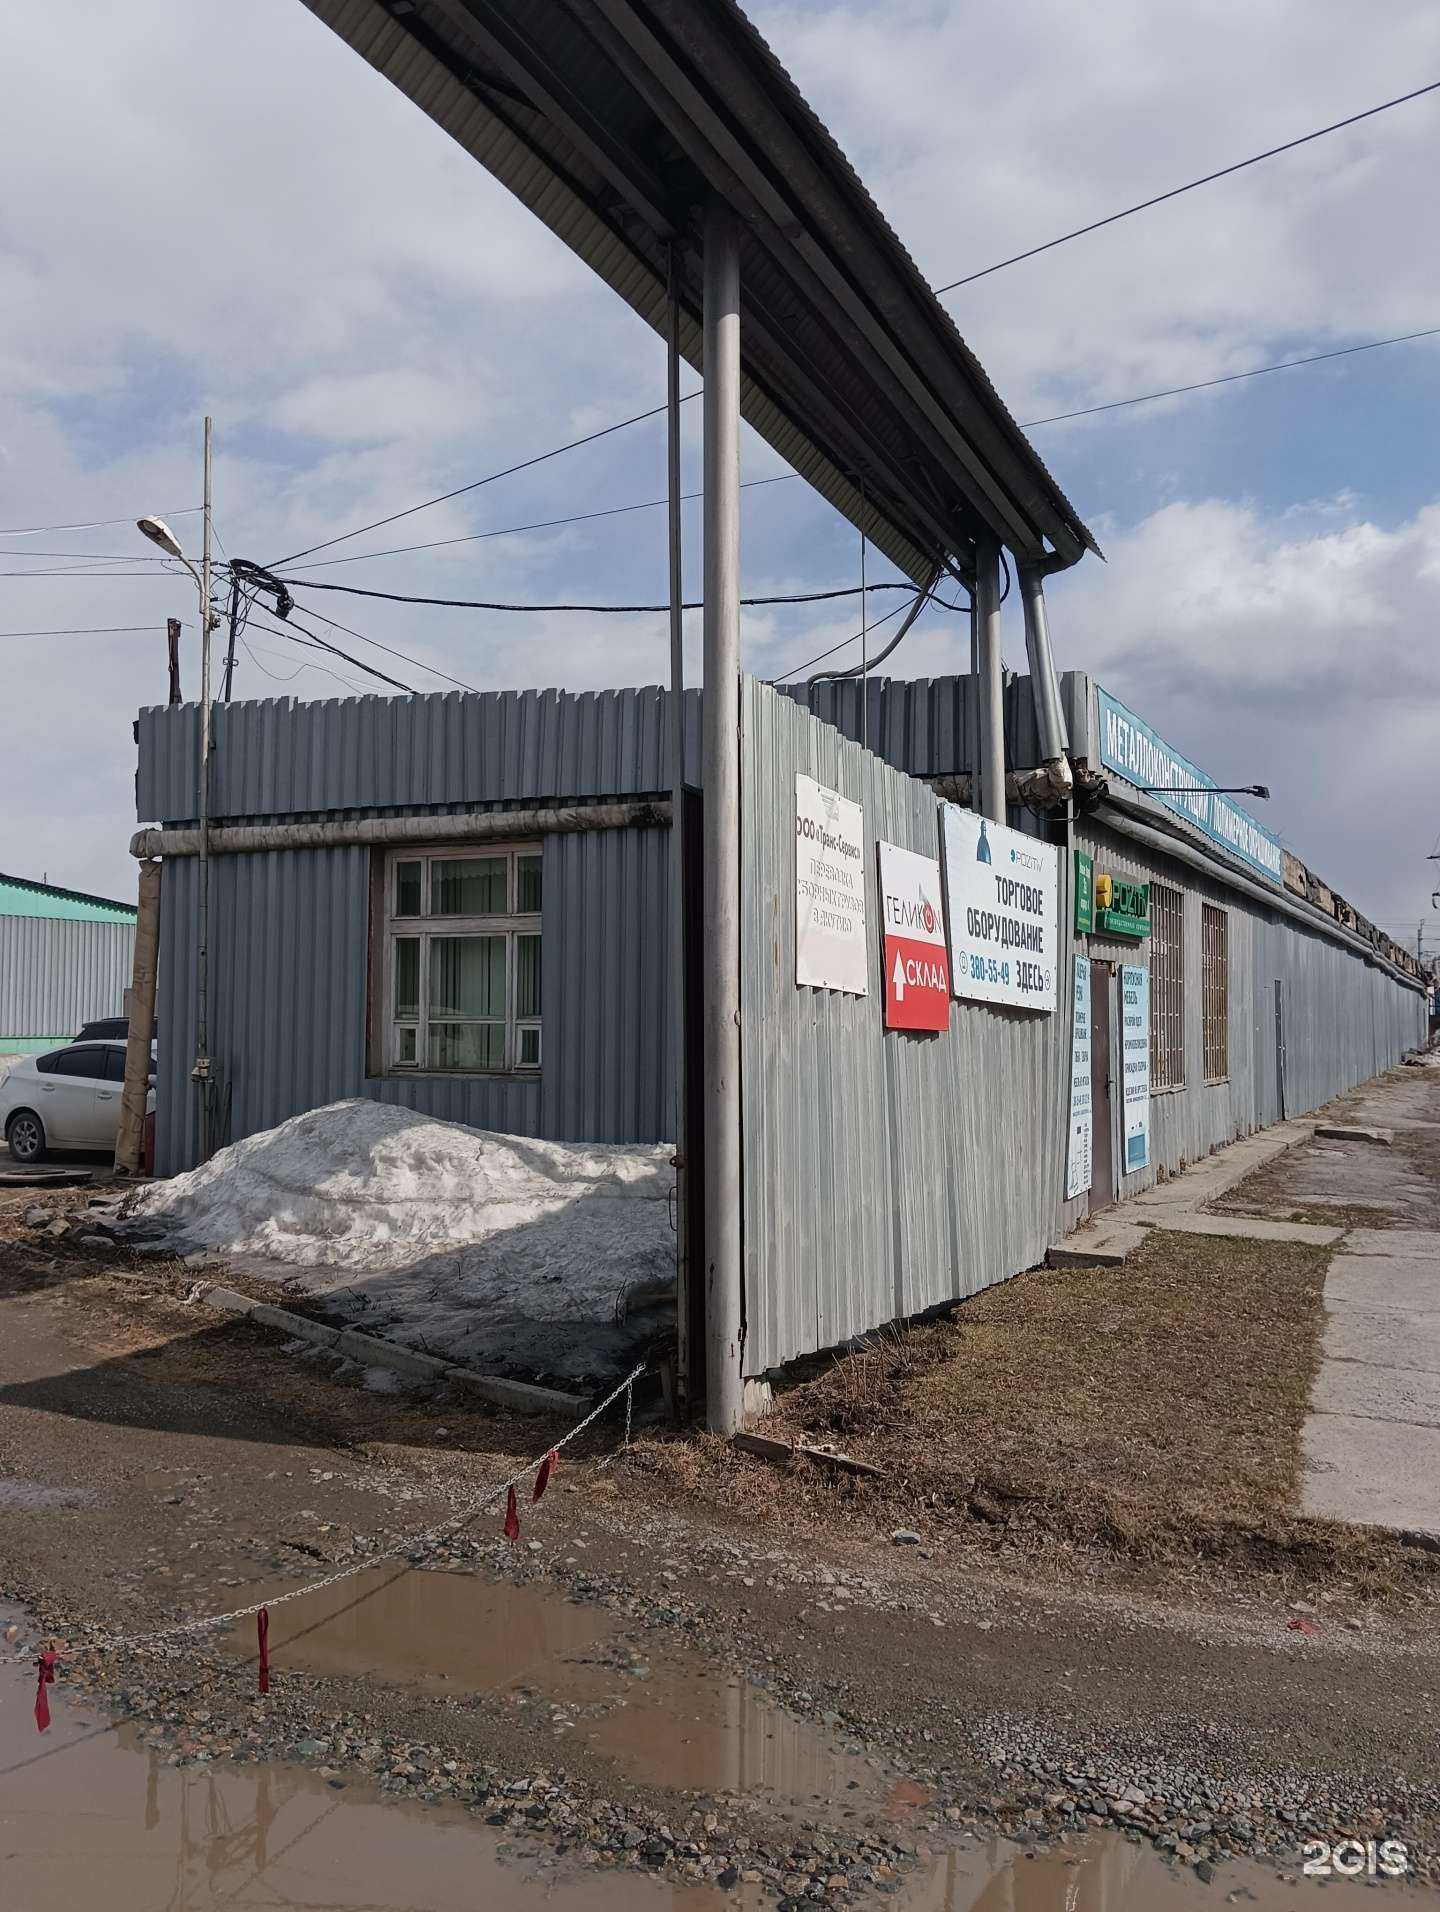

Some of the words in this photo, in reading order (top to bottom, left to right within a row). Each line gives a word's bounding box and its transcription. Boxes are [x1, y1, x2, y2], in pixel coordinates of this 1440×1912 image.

[995, 875, 1043, 916] ТОРГОВОЕ
[967, 907, 1044, 953] ОБОРУДОВАНИЕ
[906, 959, 947, 993] СКЛАД
[970, 954, 1009, 986] 380-55-49
[1016, 960, 1044, 993] ЗДЕСЬ
